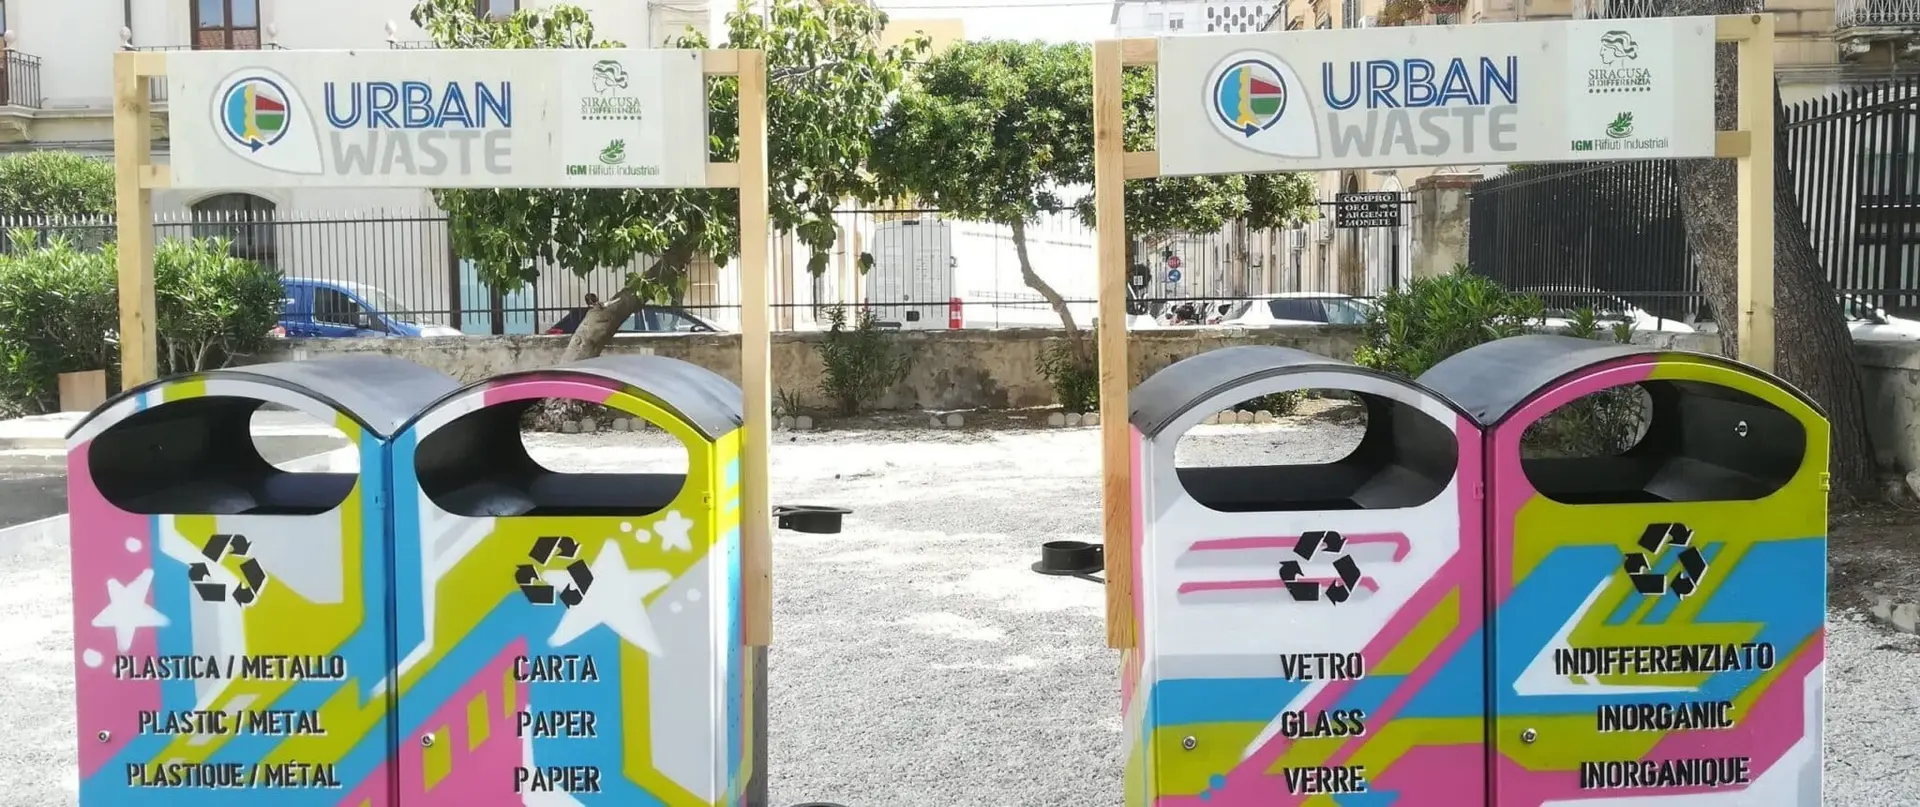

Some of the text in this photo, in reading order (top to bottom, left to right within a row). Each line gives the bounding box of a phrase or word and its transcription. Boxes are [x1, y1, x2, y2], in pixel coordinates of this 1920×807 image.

[1322, 56, 1518, 110] URBAN
[1588, 68, 1651, 80] SIRACUSA
[1597, 78, 1651, 86] DIFFERENZIA
[324, 81, 512, 129] URBAN
[581, 97, 642, 108] SIRACUSA
[1327, 105, 1518, 157] WASTE
[1571, 138, 1669, 151] IGM Rifiuti Industriali
[330, 129, 512, 175] WASTE
[566, 164, 660, 176] IGM Rifiuti Industriali
[1345, 203, 1369, 211] ORO
[1345, 211, 1398, 219] ARGENTO
[115, 655, 221, 680] PLASTICA
[241, 654, 346, 680] METALLO
[513, 655, 599, 682] CARTA
[1280, 652, 1364, 681] VETRO
[1555, 642, 1775, 676] INDIFFERENZIATO
[138, 710, 228, 735] PLASTIC
[249, 710, 326, 735] METAL
[517, 710, 597, 738] PAPER
[1281, 709, 1366, 738] GLASS
[1597, 701, 1735, 732] INORGANIC
[126, 763, 245, 788] PLASTIQUE
[265, 759, 342, 788] MÉTAL
[513, 766, 601, 793] PAPIER
[1283, 765, 1367, 794] VERRE
[1580, 757, 1750, 789] INORGANIQUE
